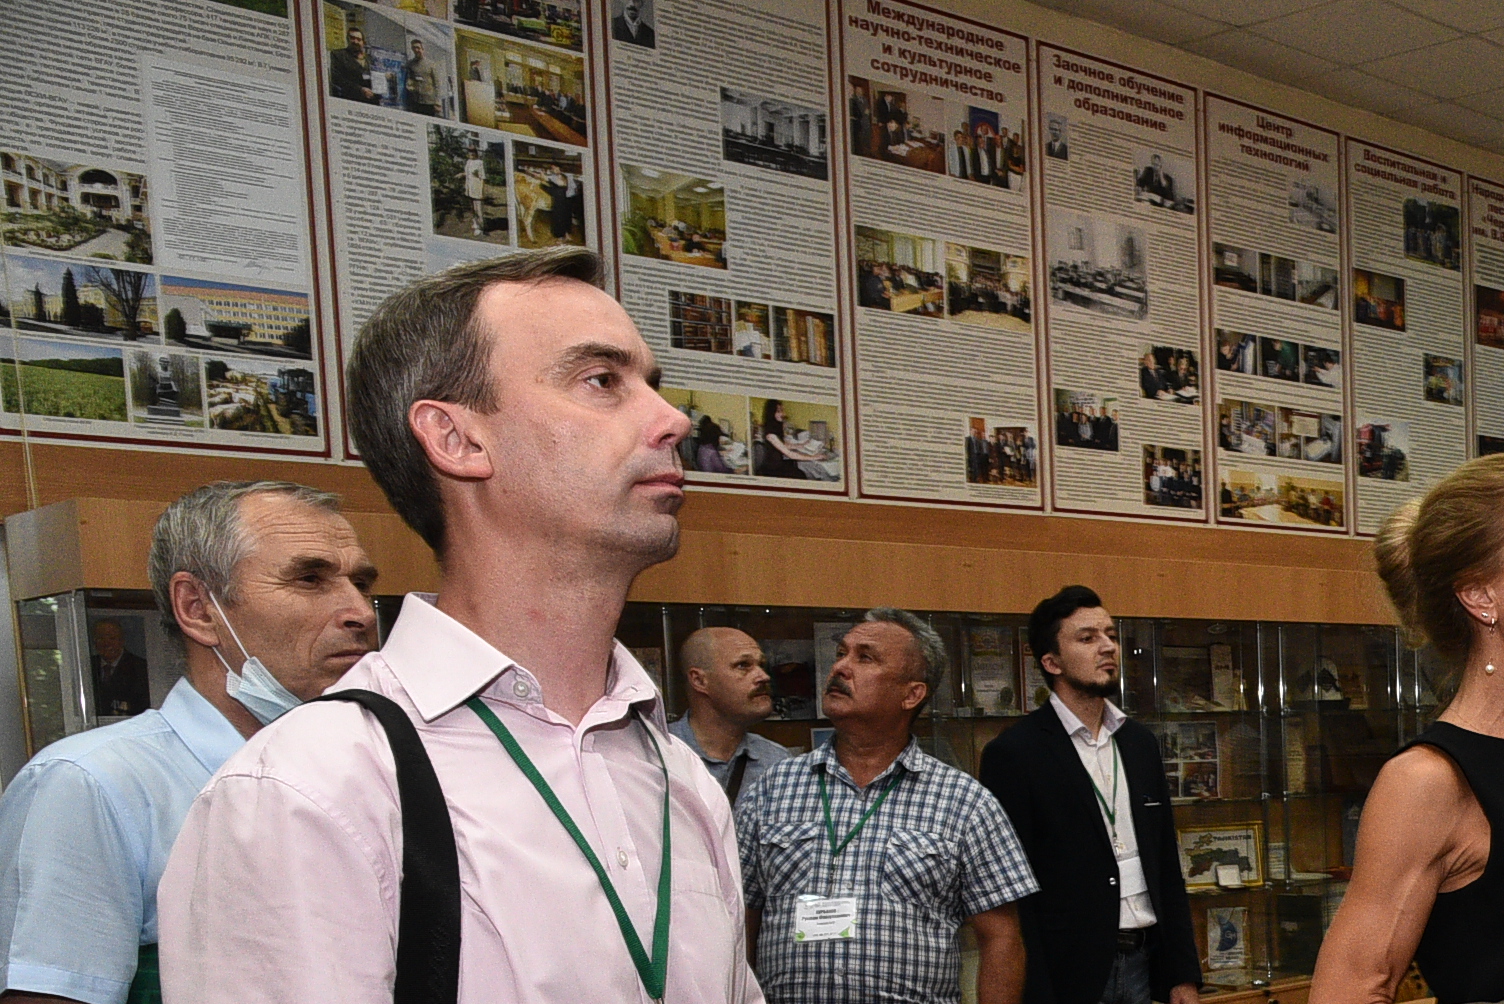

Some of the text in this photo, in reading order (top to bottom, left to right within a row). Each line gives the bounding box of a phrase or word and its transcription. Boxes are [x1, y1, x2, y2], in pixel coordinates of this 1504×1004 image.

[848, 14, 1021, 74] научно-техническое
[866, 0, 1004, 52] Международное
[870, 58, 1004, 105] сотрудничество
[881, 42, 993, 84] и культурное
[1052, 53, 1185, 106] Заочное обучение
[1054, 74, 1185, 122] и дополнительное
[1073, 97, 1168, 132] образование
[1218, 121, 1329, 163] информационных
[1256, 114, 1293, 139] Центр
[1240, 143, 1310, 173] технологий
[1354, 162, 1456, 200] социальная работа
